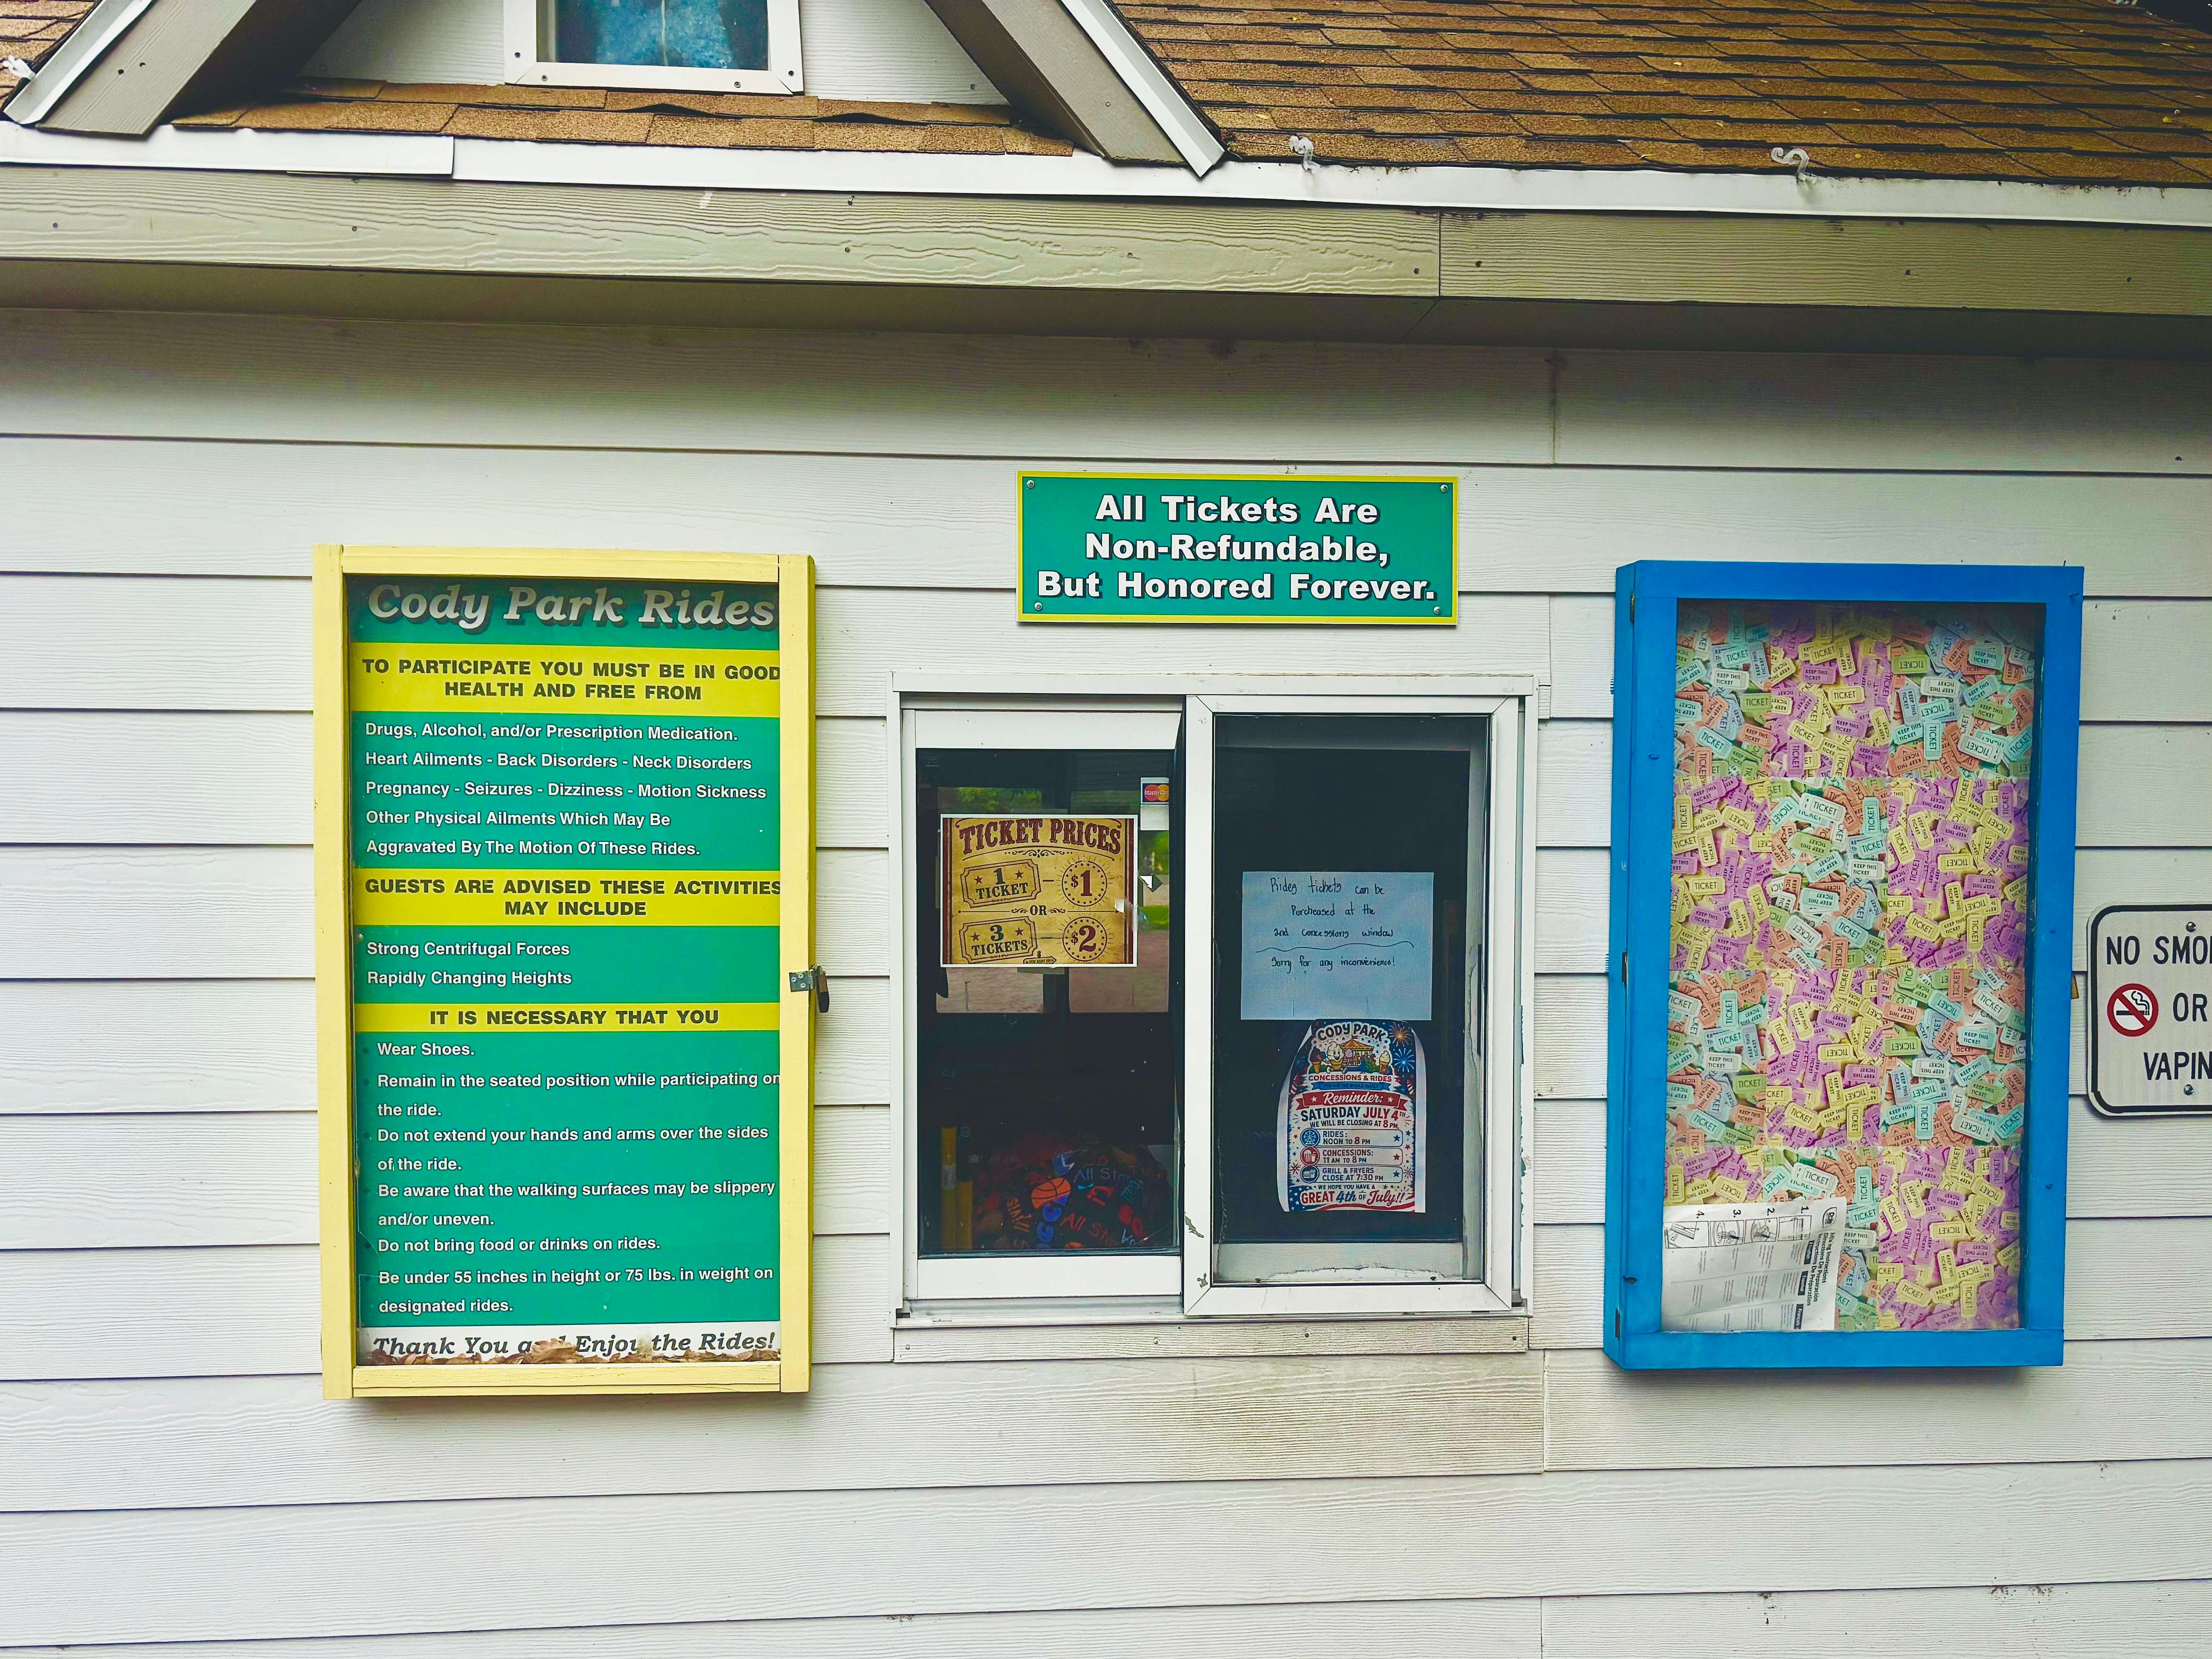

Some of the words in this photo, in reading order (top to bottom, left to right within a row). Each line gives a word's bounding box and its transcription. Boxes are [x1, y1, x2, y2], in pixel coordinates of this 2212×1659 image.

[1095, 495, 1143, 520] All
[1161, 496, 1297, 522] Tickets
[1314, 498, 1377, 523] Are
[1086, 533, 1387, 567] Non-Refundable,
[1038, 571, 1099, 597] But
[1118, 572, 1271, 598] Honored
[1290, 574, 1434, 599] Forever.
[368, 583, 489, 629] Cody
[503, 586, 624, 624] Park
[638, 588, 776, 627] Rides
[1726, 649, 1749, 662] TICKET
[362, 659, 389, 673] TO
[399, 659, 531, 675] PARTICIPATE
[540, 661, 583, 676] YOU
[593, 662, 650, 677] MUST
[660, 664, 685, 678] BE
[695, 665, 715, 679] IN
[725, 665, 780, 680] GOOD
[445, 682, 523, 697] HEALTH
[533, 683, 575, 697] AND
[585, 684, 635, 699] FREE
[645, 685, 701, 700] FROM
[1833, 691, 1856, 700] TICKET
[366, 722, 416, 739] Drugs,
[421, 723, 486, 738] Alcohol,
[491, 724, 542, 737] and/or
[547, 725, 642, 741] Prescription
[648, 727, 737, 740] Medication.
[1794, 725, 1815, 741] TICKET
[1814, 801, 1837, 816] TICKET
[960, 819, 1042, 854] TICKET
[1050, 819, 1121, 855] PRICES
[994, 868, 1006, 885] 1
[1070, 870, 1093, 897] $1
[365, 879, 445, 893] GUESTS
[454, 880, 494, 893] ARE
[503, 880, 591, 894] ADVISED
[600, 880, 665, 894] THESE
[674, 880, 780, 895] ACTIVITIES
[976, 882, 1029, 899] TICKET
[1308, 876, 1341, 893] tickets
[1355, 885, 1369, 894] can
[1375, 883, 1385, 895] be
[505, 901, 548, 915] MAY
[558, 901, 646, 916] INCLUDE
[1030, 905, 1047, 916] OR
[1345, 902, 1355, 915] at
[1362, 904, 1375, 915] the
[990, 925, 1004, 941] 3
[1071, 925, 1097, 952] $2
[1362, 926, 1393, 937] window
[367, 942, 419, 958] Strong
[424, 942, 511, 958] Centrifugal
[517, 942, 569, 955] Forces
[972, 939, 1028, 956] TICKETS
[2107, 935, 2140, 965] NO
[2153, 935, 2212, 965] SMO
[1271, 955, 1292, 973] Sorry
[1299, 956, 1311, 967] for
[1319, 958, 1333, 971] any
[368, 971, 426, 987] Rapidly
[431, 971, 506, 987] Changing
[512, 971, 571, 987] Heights
[2173, 992, 2207, 1022] OR
[430, 1011, 448, 1025] IT
[458, 1011, 477, 1025] IS
[487, 1010, 607, 1025] NECESSARY
[615, 1010, 668, 1024] THAT
[676, 1010, 718, 1024] YOU
[1317, 1023, 1351, 1041] CODY
[1353, 1023, 1387, 1041] PARK
[377, 1043, 416, 1055] Wear
[421, 1042, 474, 1055] Shoes.
[2144, 1051, 2212, 1080] VAPIN
[1323, 1091, 1383, 1106] Reminder:
[1300, 1107, 1361, 1122] SATURDAY
[1363, 1107, 1390, 1119] JULY
[1391, 1110, 1406, 1121] 4TH
[1921, 1106, 1929, 1130] TICKET
[1301, 1191, 1335, 1203] GREAT
[1336, 1191, 1356, 1202] 4th
[1367, 1190, 1404, 1207] July!!
[1854, 1208, 1876, 1221] TICKET
[378, 1240, 399, 1251] Do
[405, 1240, 429, 1251] not
[435, 1239, 474, 1254] bring
[479, 1238, 514, 1251] food
[519, 1241, 535, 1251] or
[539, 1237, 588, 1250] drinks
[593, 1240, 612, 1250] on
[618, 1237, 660, 1249] rides.
[1902, 1285, 1923, 1299] TICKET
[373, 1337, 454, 1354] Thank
[465, 1337, 508, 1354] You
[653, 1334, 690, 1350] the
[699, 1332, 775, 1351] Rides!
